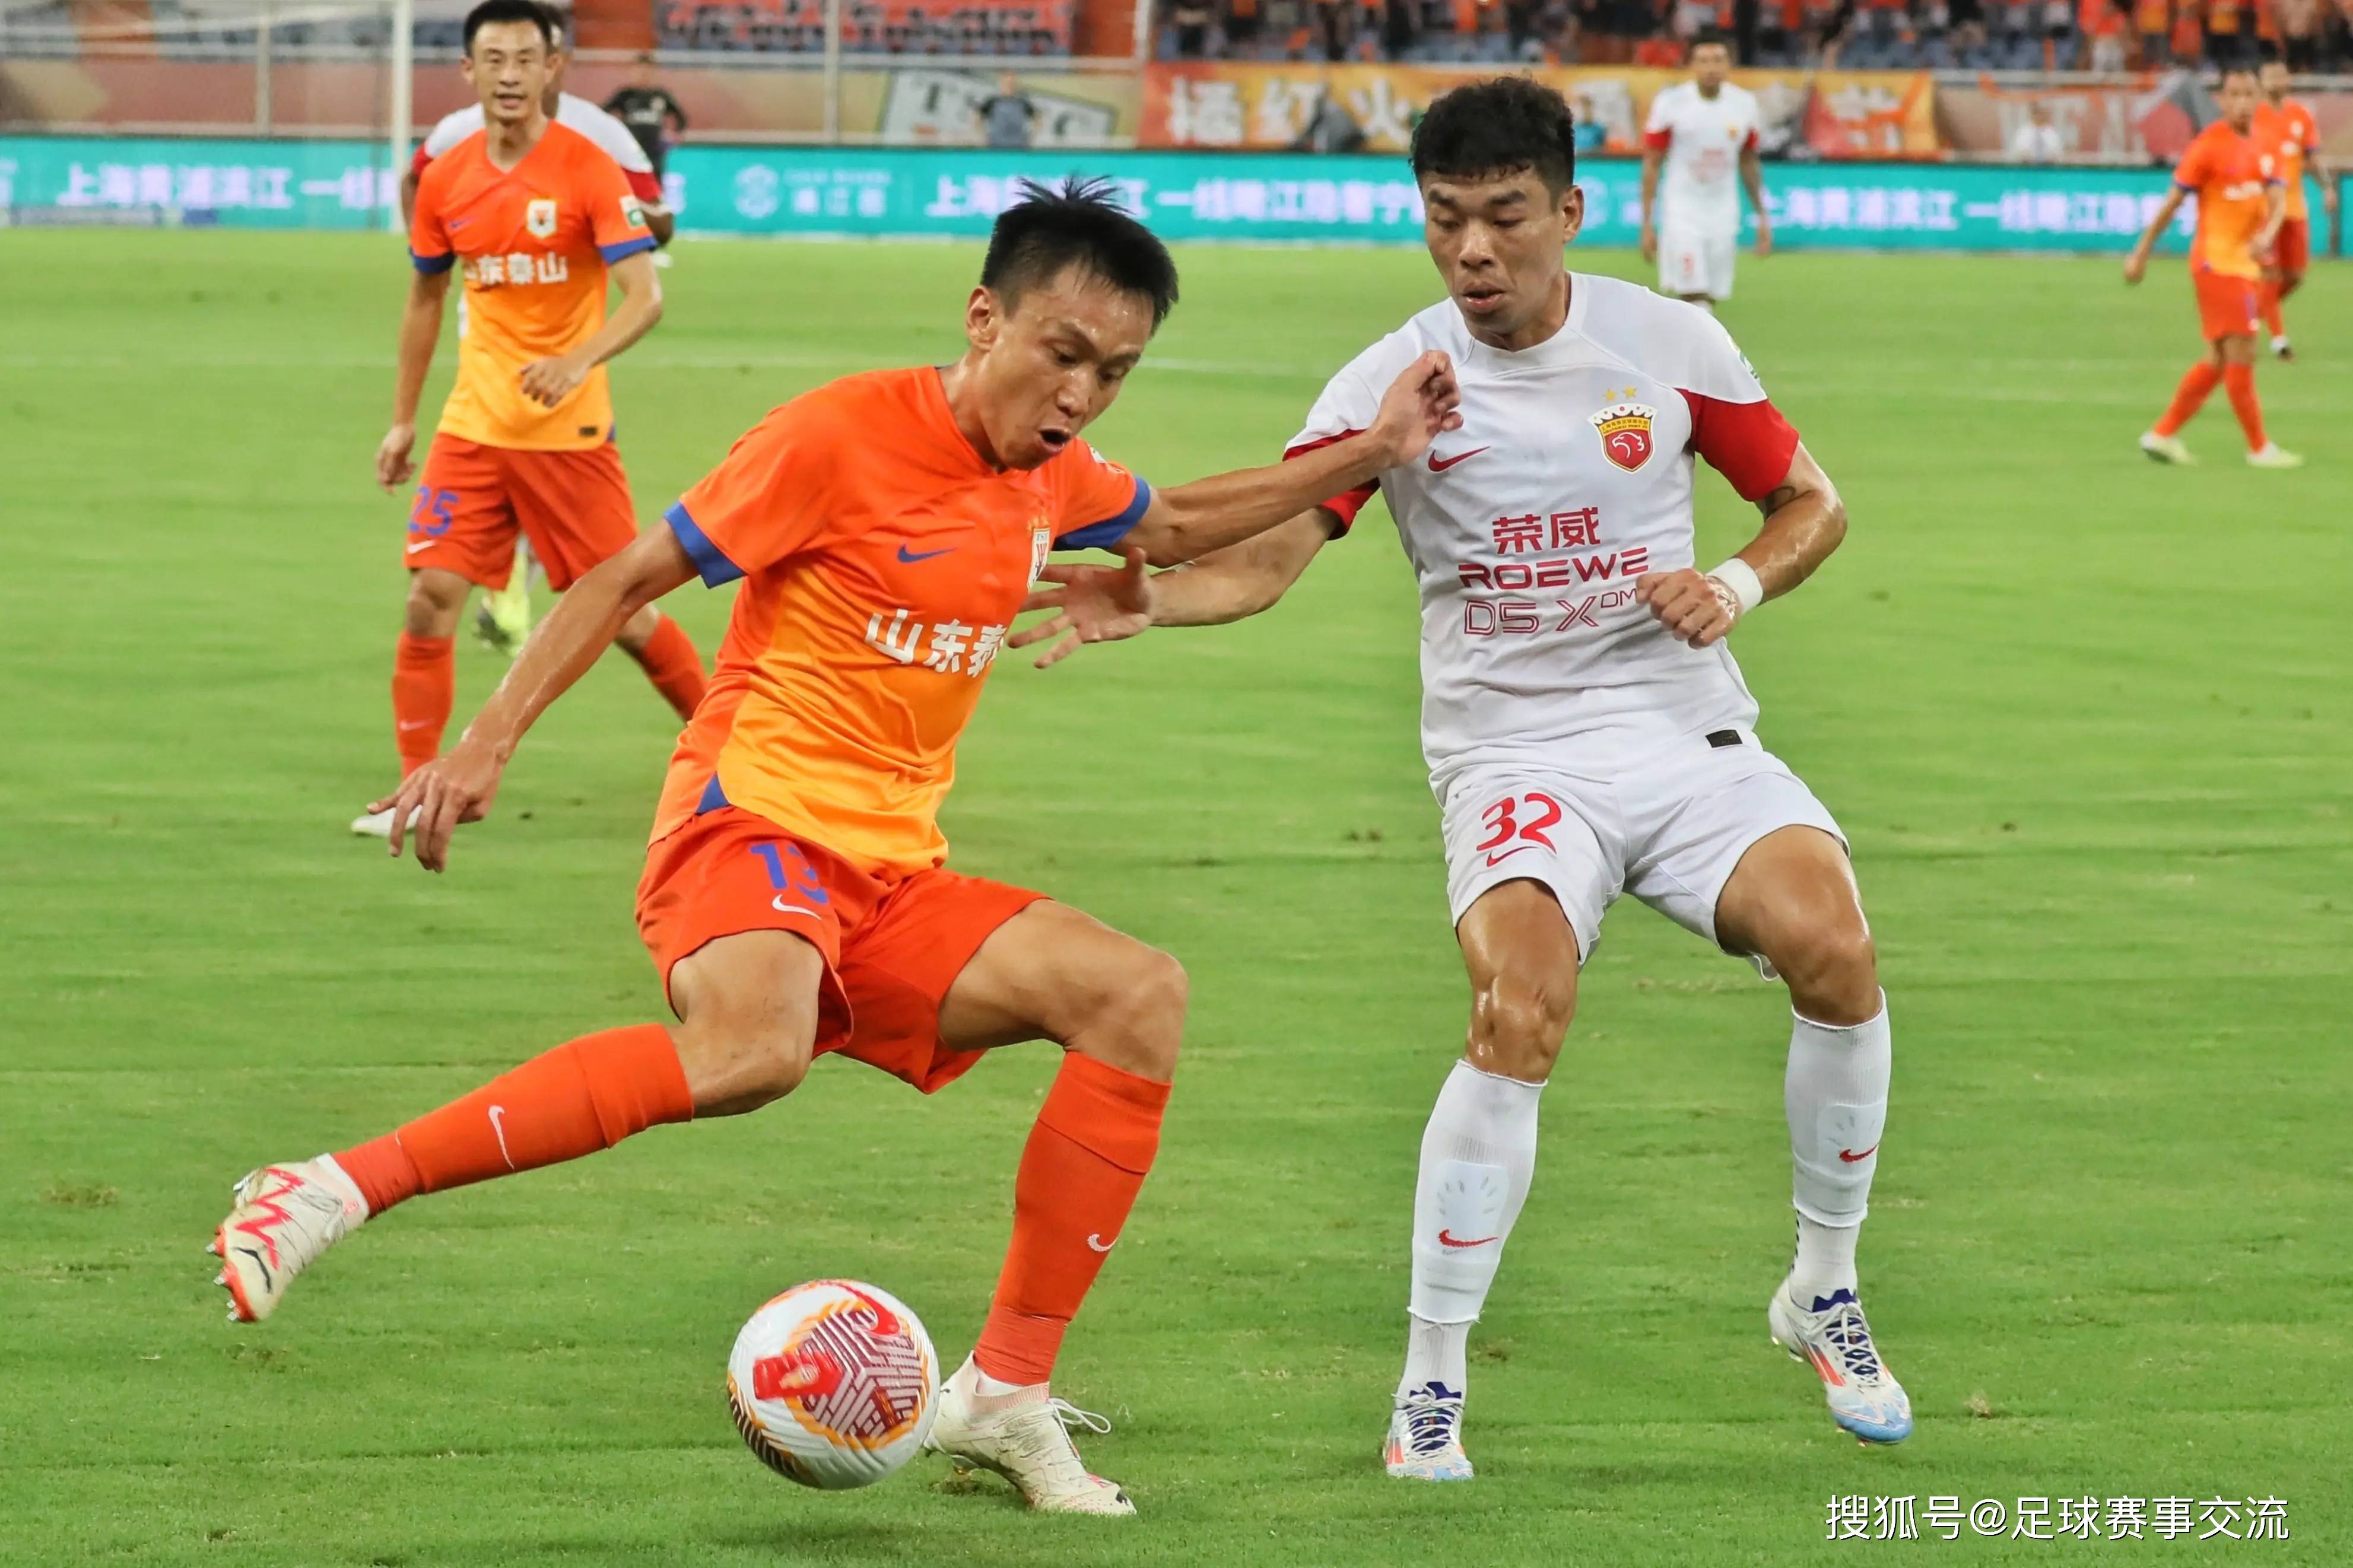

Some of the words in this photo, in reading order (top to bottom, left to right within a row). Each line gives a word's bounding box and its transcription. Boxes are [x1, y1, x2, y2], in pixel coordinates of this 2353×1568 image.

[407, 485, 459, 535] 25
[1492, 507, 1601, 554] 荣威
[1458, 547, 1649, 590] ROEWE
[864, 609, 1008, 678] 山东泰
[1476, 793, 1563, 854] 32
